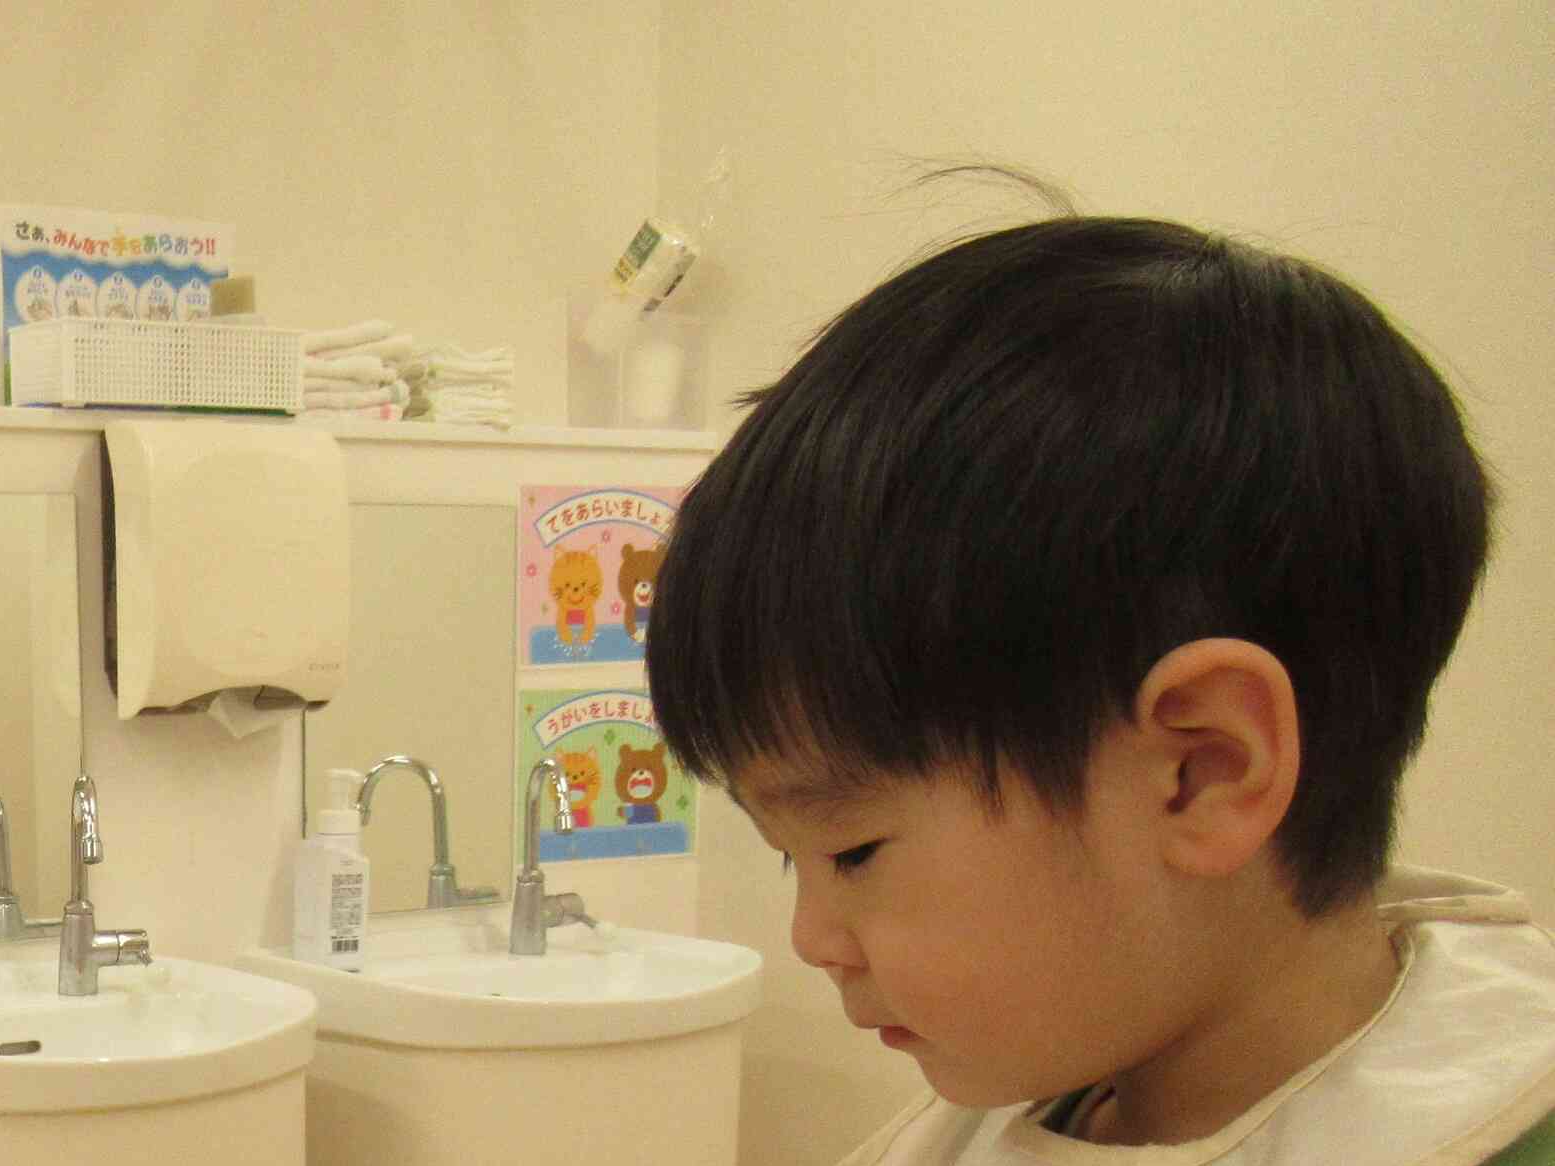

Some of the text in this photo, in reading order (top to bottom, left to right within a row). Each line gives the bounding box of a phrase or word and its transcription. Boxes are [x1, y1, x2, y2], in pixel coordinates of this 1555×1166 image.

[547, 498, 674, 534] てをあらいましょ
